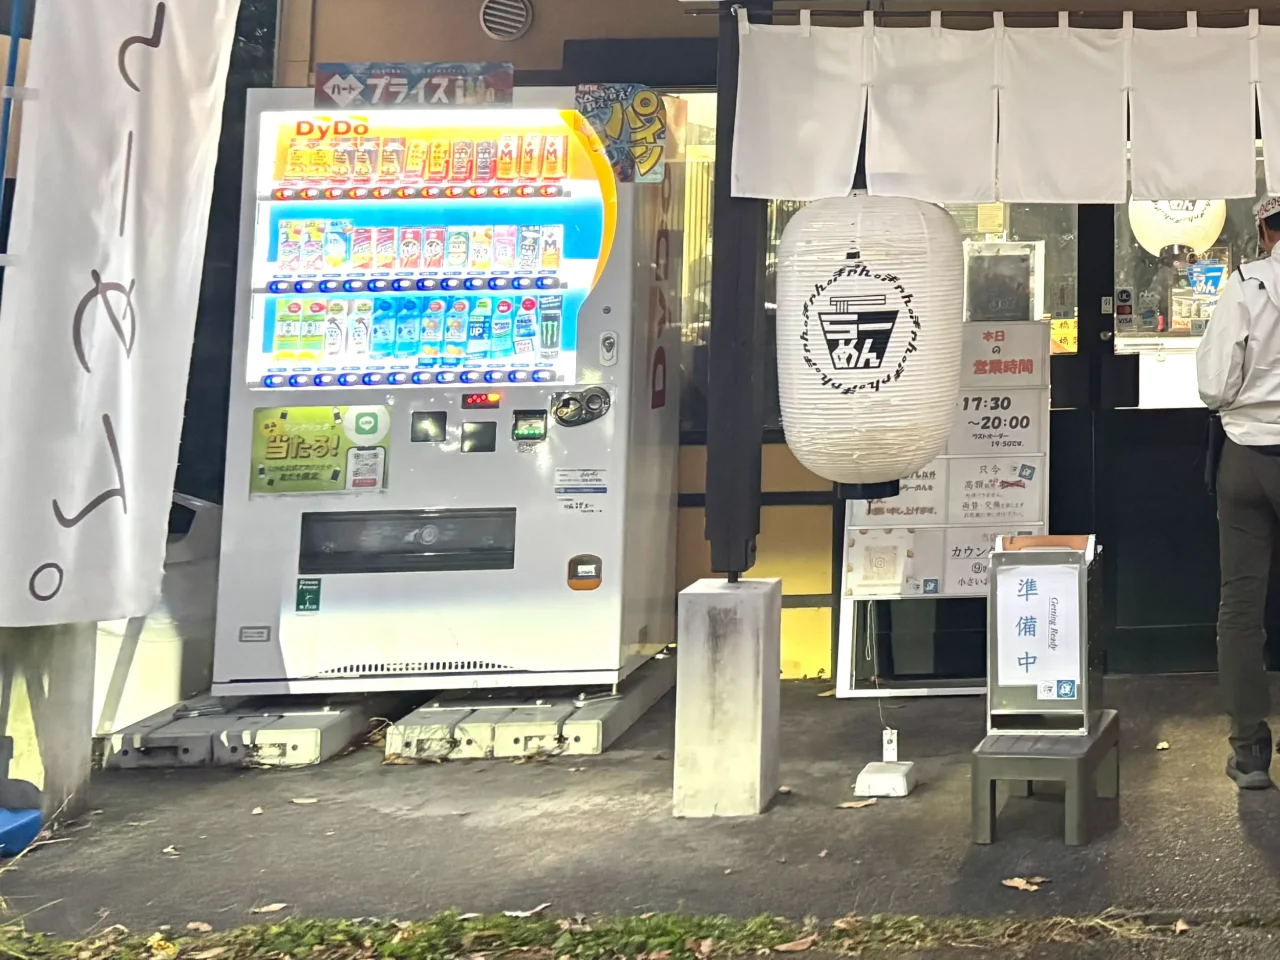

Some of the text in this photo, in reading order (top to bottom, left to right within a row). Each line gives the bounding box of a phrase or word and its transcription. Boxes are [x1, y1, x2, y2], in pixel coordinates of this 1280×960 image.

[366, 76, 449, 104] プライス
[296, 120, 369, 141] DyDo
[604, 89, 665, 178] パイン
[982, 330, 1005, 342] 本日
[992, 345, 1001, 354] の
[973, 359, 1034, 375] 営業時間
[962, 396, 1012, 411] 17:30
[1015, 577, 1039, 674] 準備中
[1048, 626, 1060, 651] Ready
